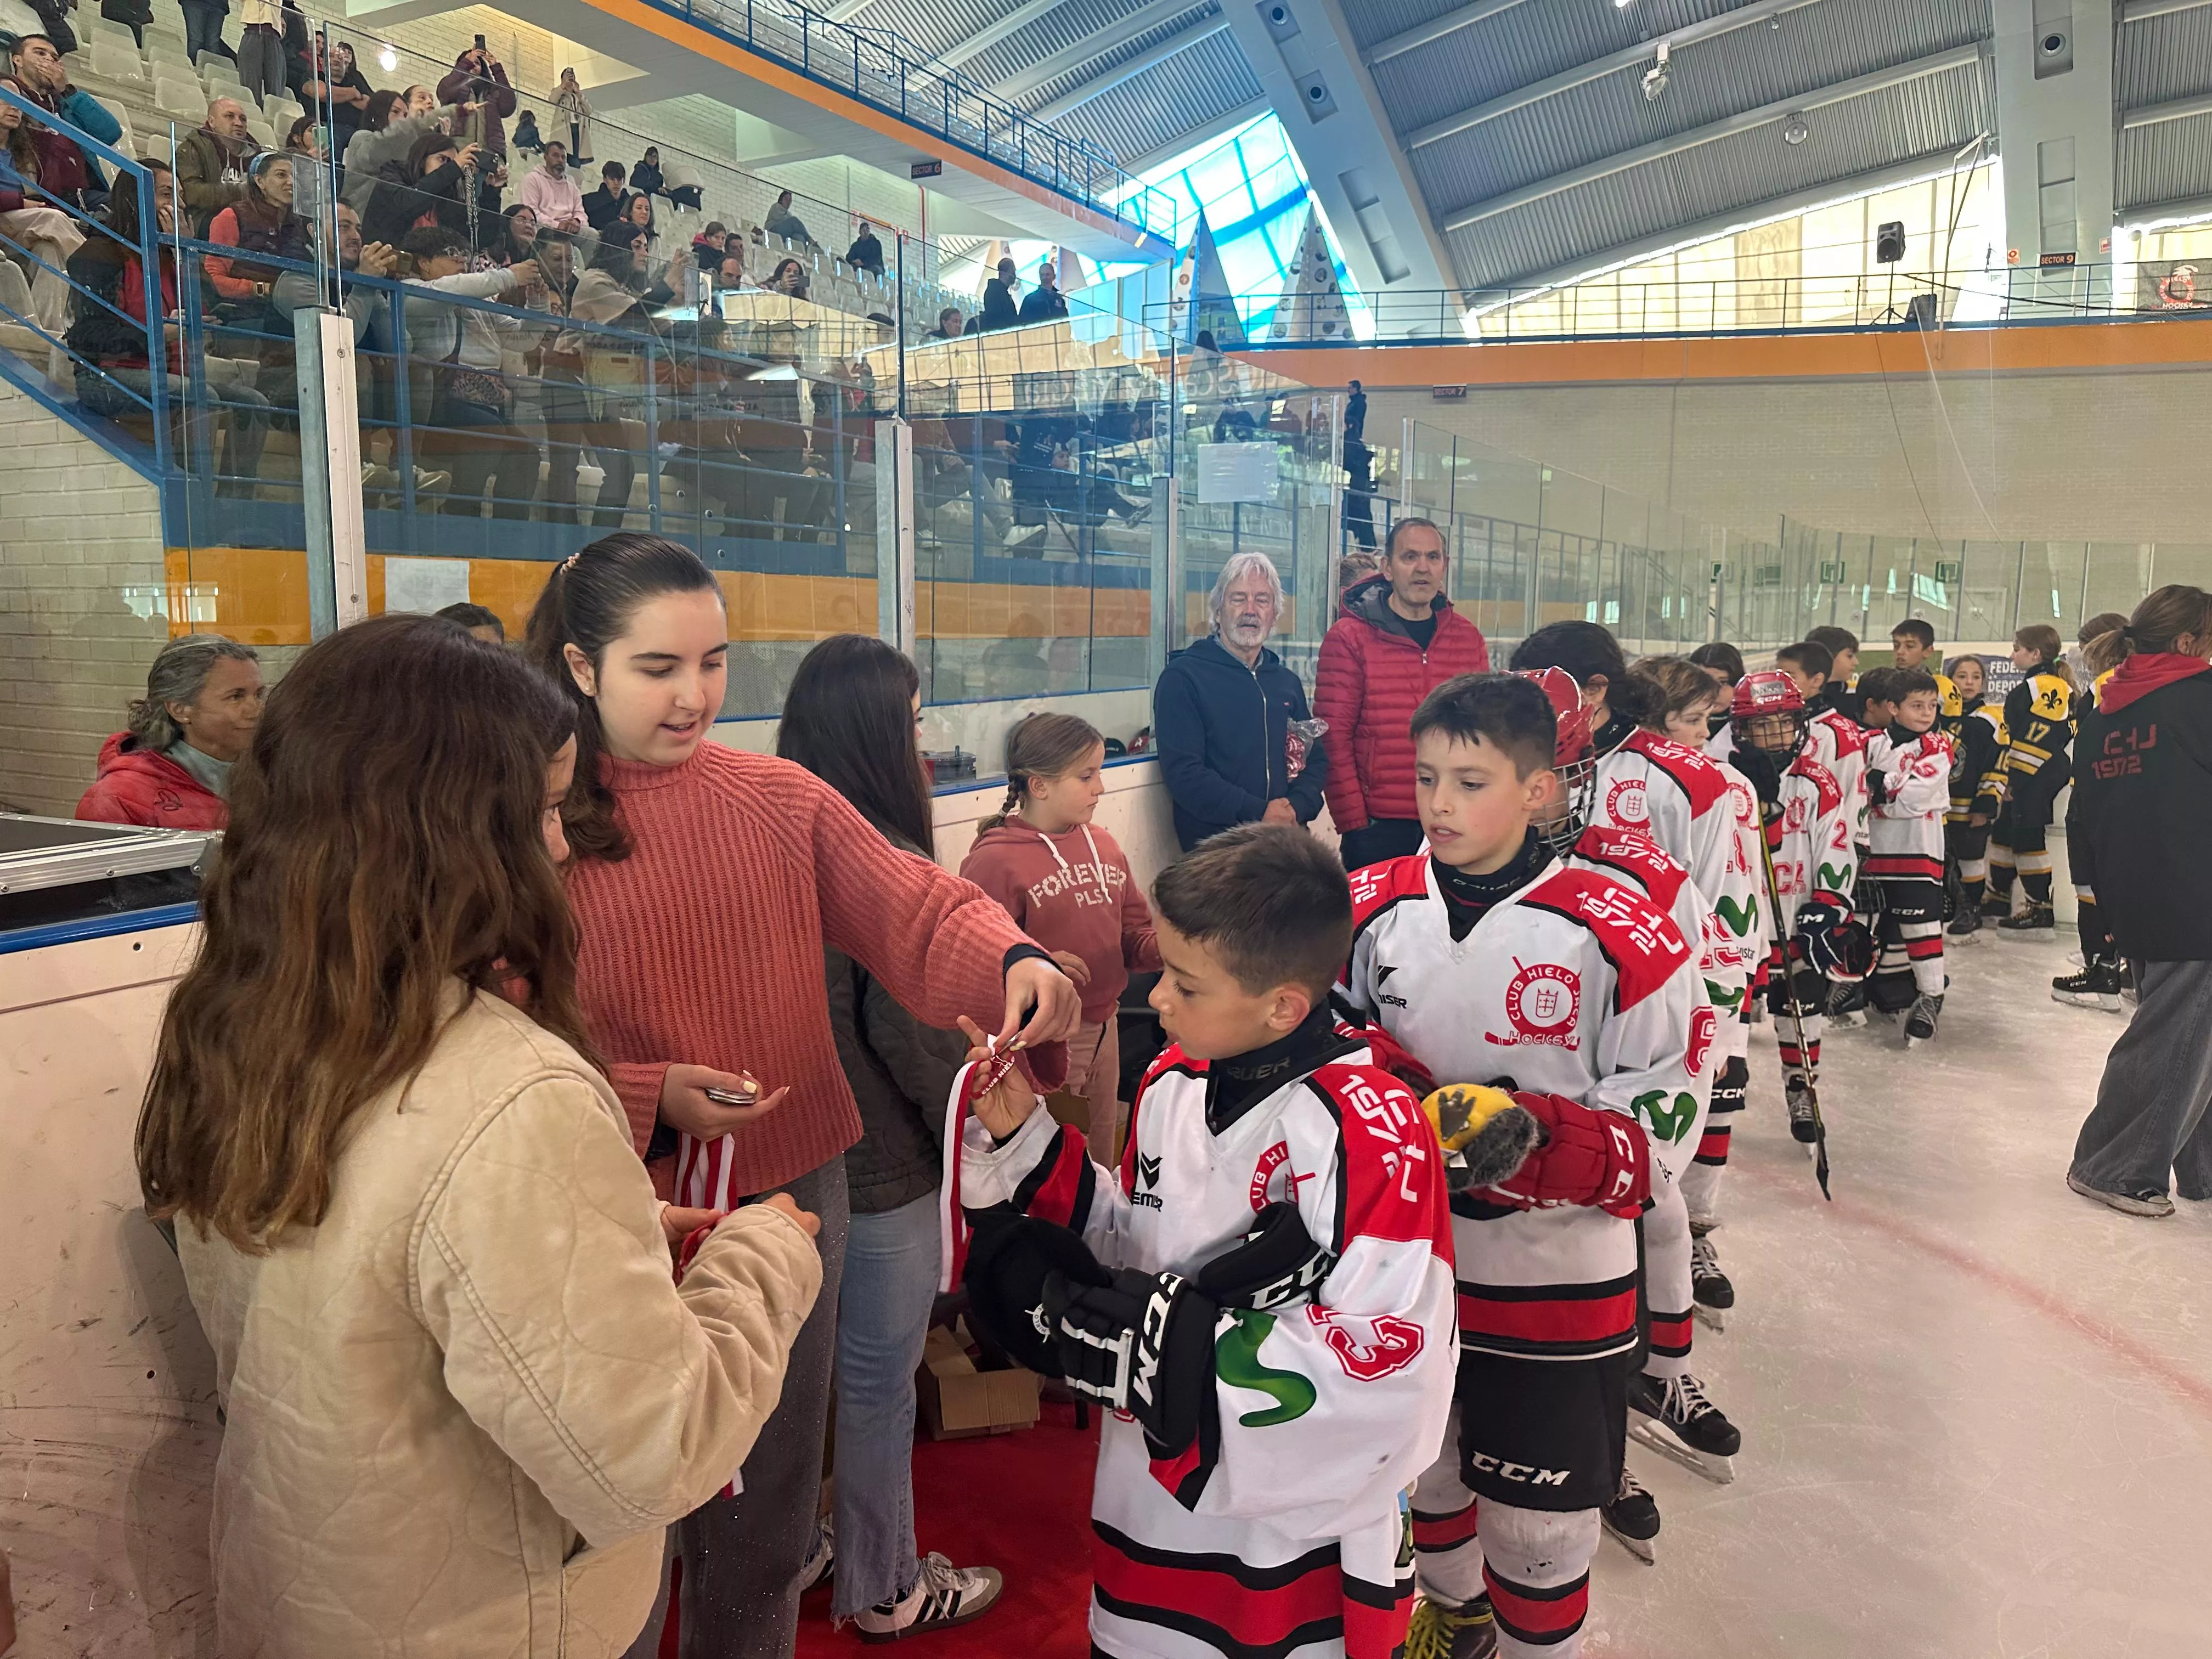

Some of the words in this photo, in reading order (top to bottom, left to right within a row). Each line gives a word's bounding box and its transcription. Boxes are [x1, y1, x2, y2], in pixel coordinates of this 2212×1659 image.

[912, 165, 932, 175] SECTOR
[935, 163, 941, 173] 6
[2067, 255, 2074, 263] 9
[1458, 386, 1464, 396] 7
[2024, 720, 2050, 743] 17
[2091, 754, 2142, 780] 1972
[1608, 790, 1618, 816] CLUB
[1620, 781, 1645, 789] HIEL
[1831, 820, 1848, 851] 2
[1028, 862, 1127, 909] FOREVER
[1509, 980, 1523, 1020] CLUB
[1527, 967, 1574, 984] HIELO
[1566, 990, 1581, 1027] JACA
[1509, 1030, 1576, 1047] HOCKEY
[981, 1077, 998, 1095] CLUB
[997, 1056, 1015, 1077] HIELO
[1252, 1172, 1266, 1211] LUB
[1133, 1272, 1184, 1407] CCM
[1472, 1451, 1571, 1486] CCM
